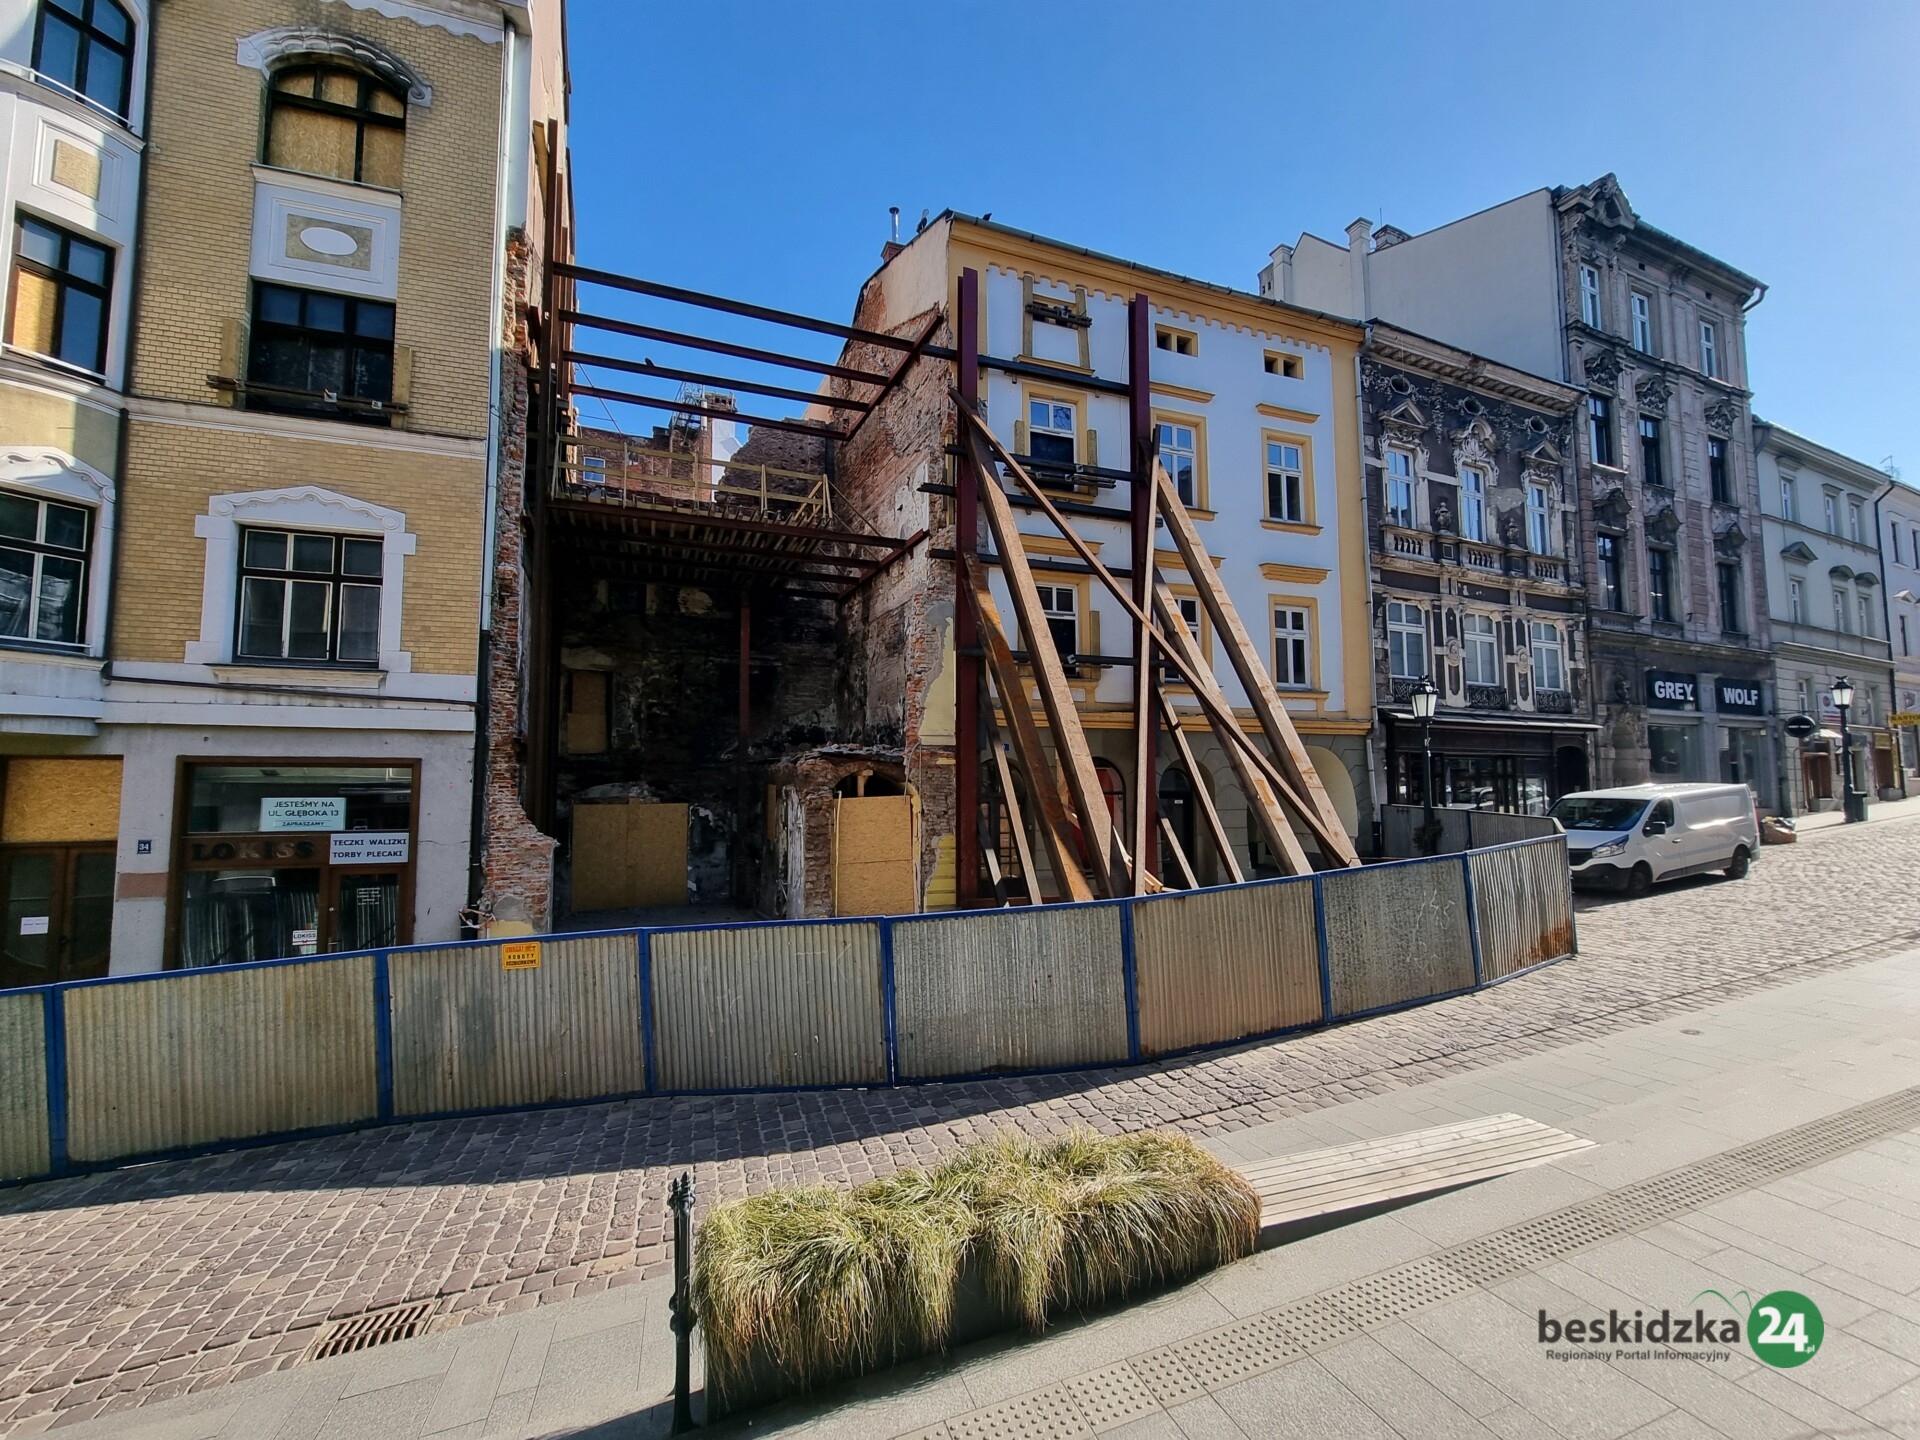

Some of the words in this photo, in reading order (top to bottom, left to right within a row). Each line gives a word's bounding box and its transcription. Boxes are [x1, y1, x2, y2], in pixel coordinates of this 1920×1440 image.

[1654, 680, 1694, 701] GREY
[1723, 687, 1758, 706] WOLF
[274, 800, 319, 808] JESTEŚMY
[285, 809, 328, 818] GŁĘBOKA
[330, 809, 340, 817] 13
[138, 843, 150, 851] 34
[333, 839, 365, 847] TECZKI
[369, 838, 407, 846] WALIZKI
[191, 840, 315, 861] LOKISS
[333, 851, 362, 859] TORBY
[366, 850, 403, 858] PLECAKI
